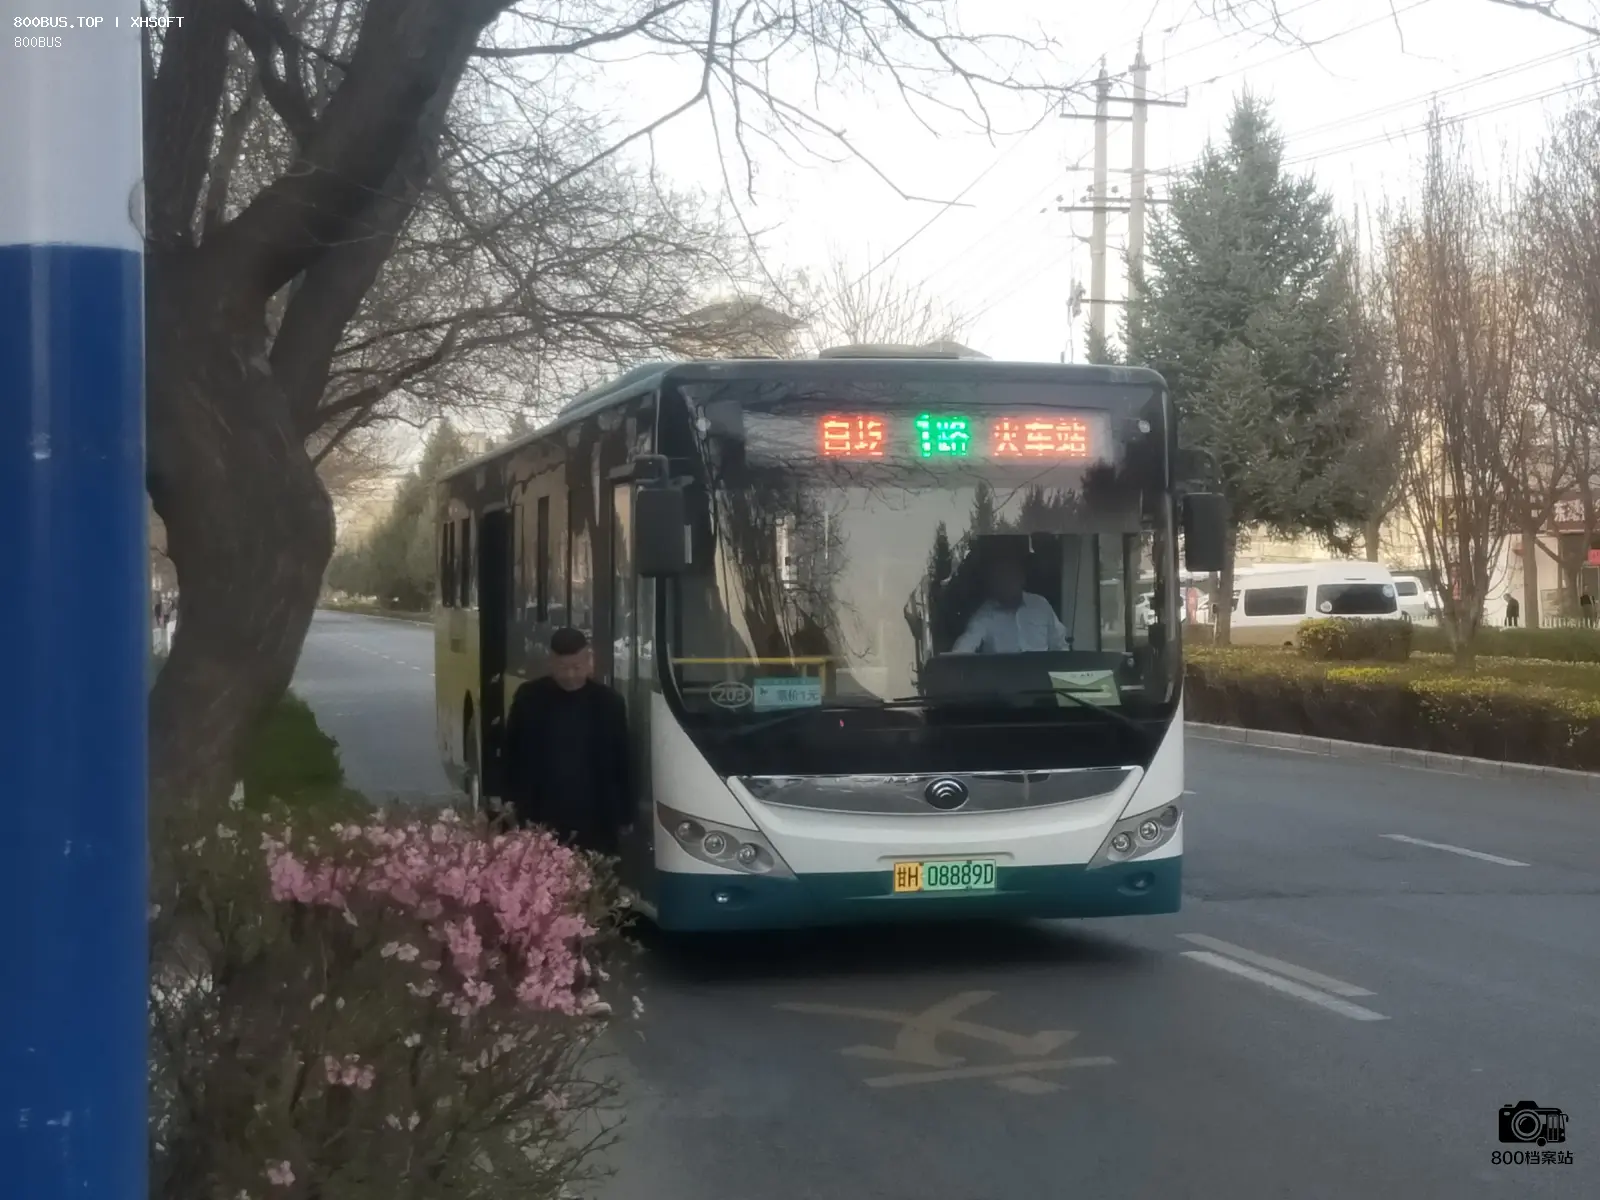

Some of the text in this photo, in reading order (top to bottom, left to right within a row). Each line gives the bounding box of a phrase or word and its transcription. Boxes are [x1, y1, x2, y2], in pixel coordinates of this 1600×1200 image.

[915, 413, 969, 458] 1路
[993, 416, 1087, 456] 火车站
[716, 686, 747, 702] 203
[896, 863, 994, 888] 甘H 08889D
